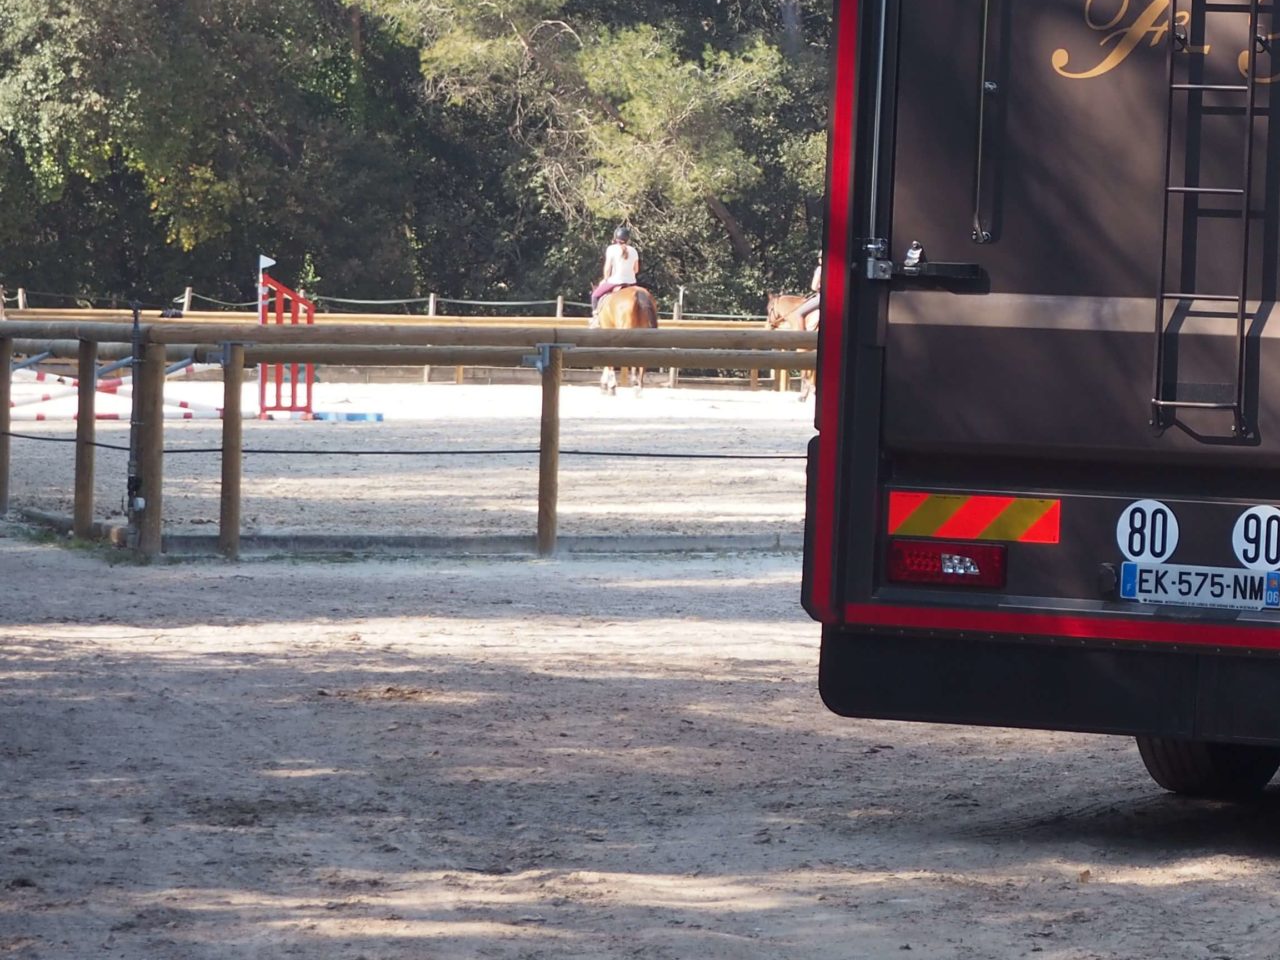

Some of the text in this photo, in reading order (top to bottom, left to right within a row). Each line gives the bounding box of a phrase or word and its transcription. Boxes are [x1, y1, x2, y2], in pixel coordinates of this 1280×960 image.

[1128, 507, 1168, 557] 80
[1138, 569, 1265, 601] EK-575-NM
[1266, 591, 1279, 604] 06
